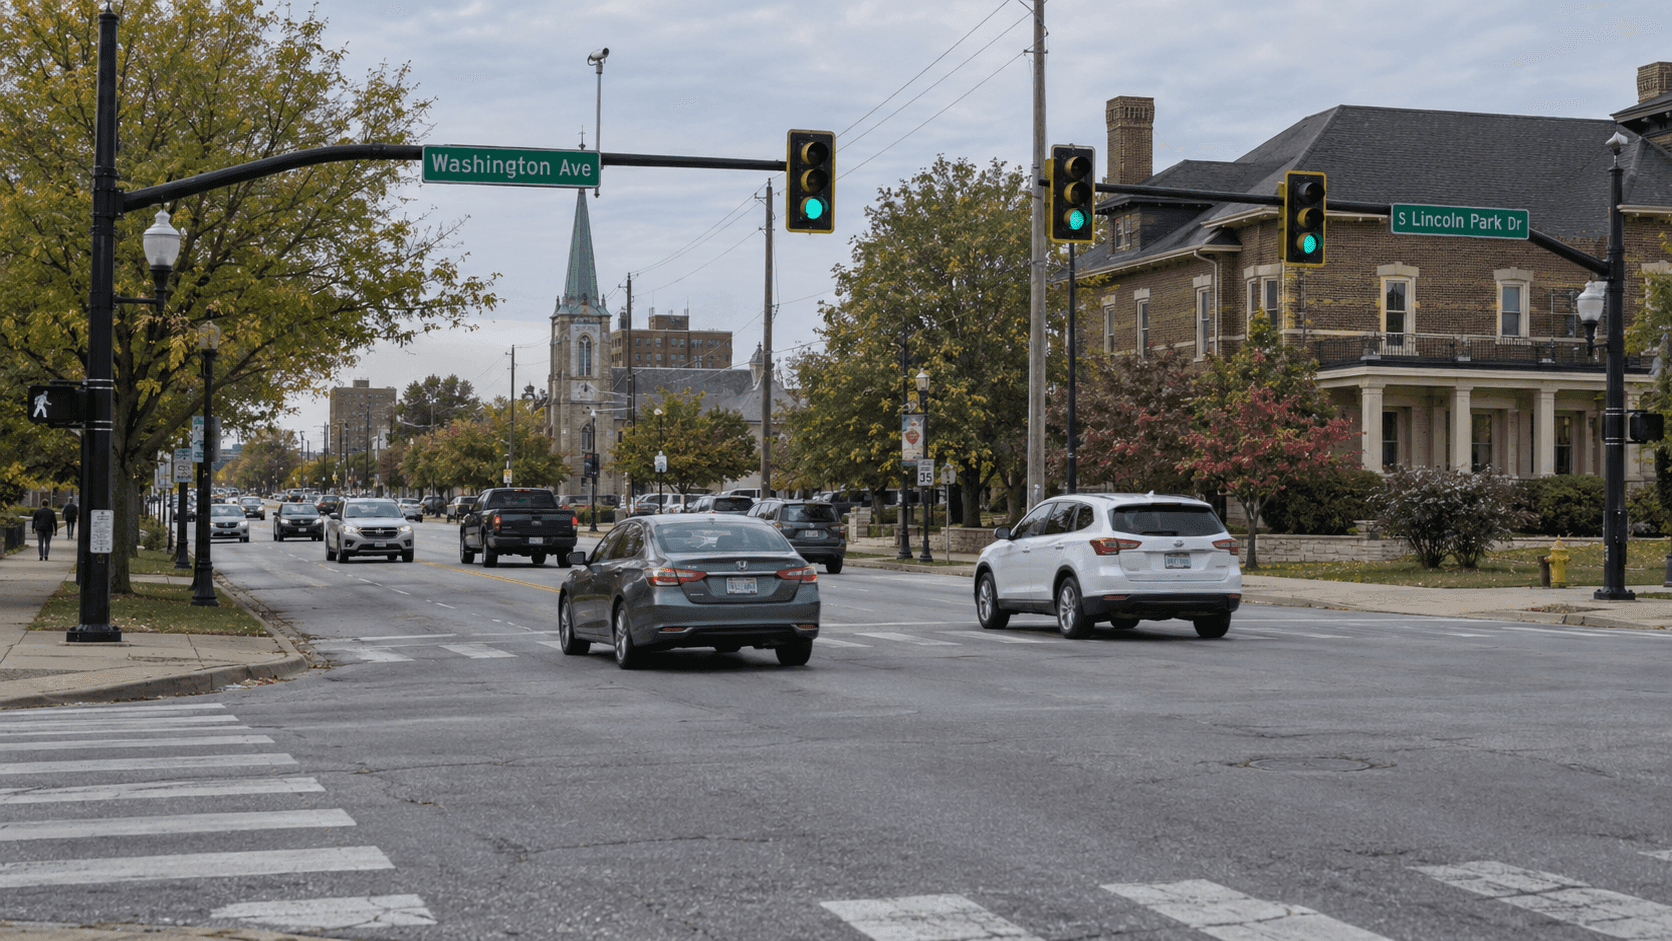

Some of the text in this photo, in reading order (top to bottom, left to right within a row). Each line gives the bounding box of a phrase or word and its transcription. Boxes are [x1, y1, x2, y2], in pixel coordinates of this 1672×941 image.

[431, 153, 592, 179] Washington Ave
[1398, 211, 1523, 231] S Lincoln Park Dr
